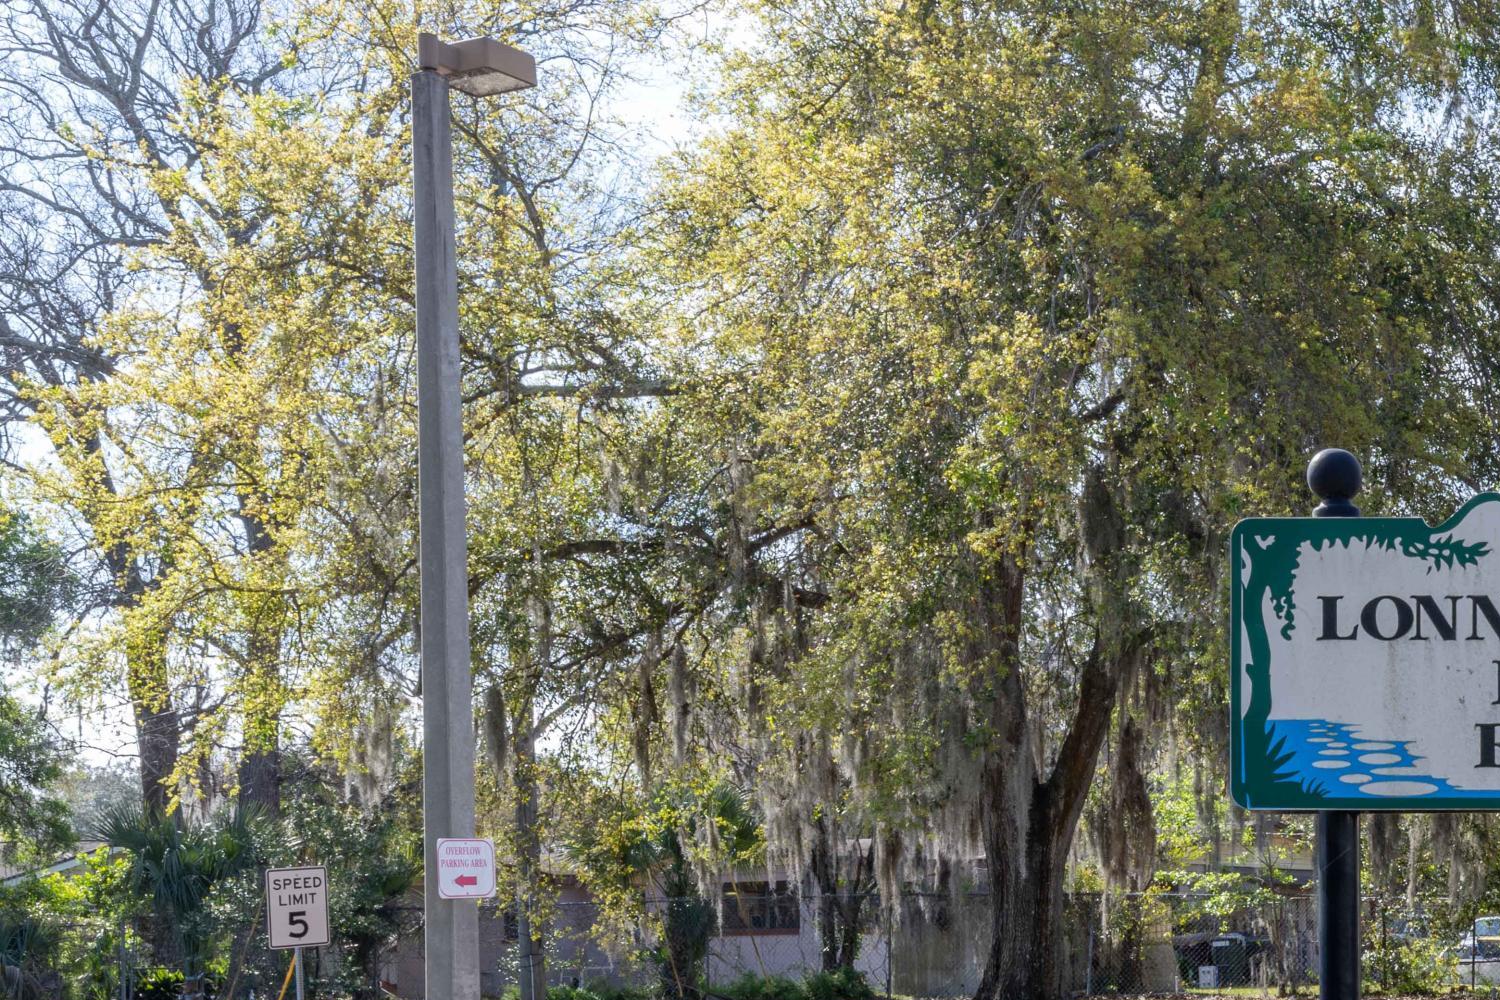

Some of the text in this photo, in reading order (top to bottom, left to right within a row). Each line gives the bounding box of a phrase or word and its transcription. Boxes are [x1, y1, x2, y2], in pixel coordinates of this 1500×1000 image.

[445, 846, 481, 856] OVERFLOW
[440, 859, 488, 868] PARKING AREA
[273, 877, 321, 890] SPEED
[279, 893, 316, 906] LIMIT
[289, 911, 308, 938] 5
